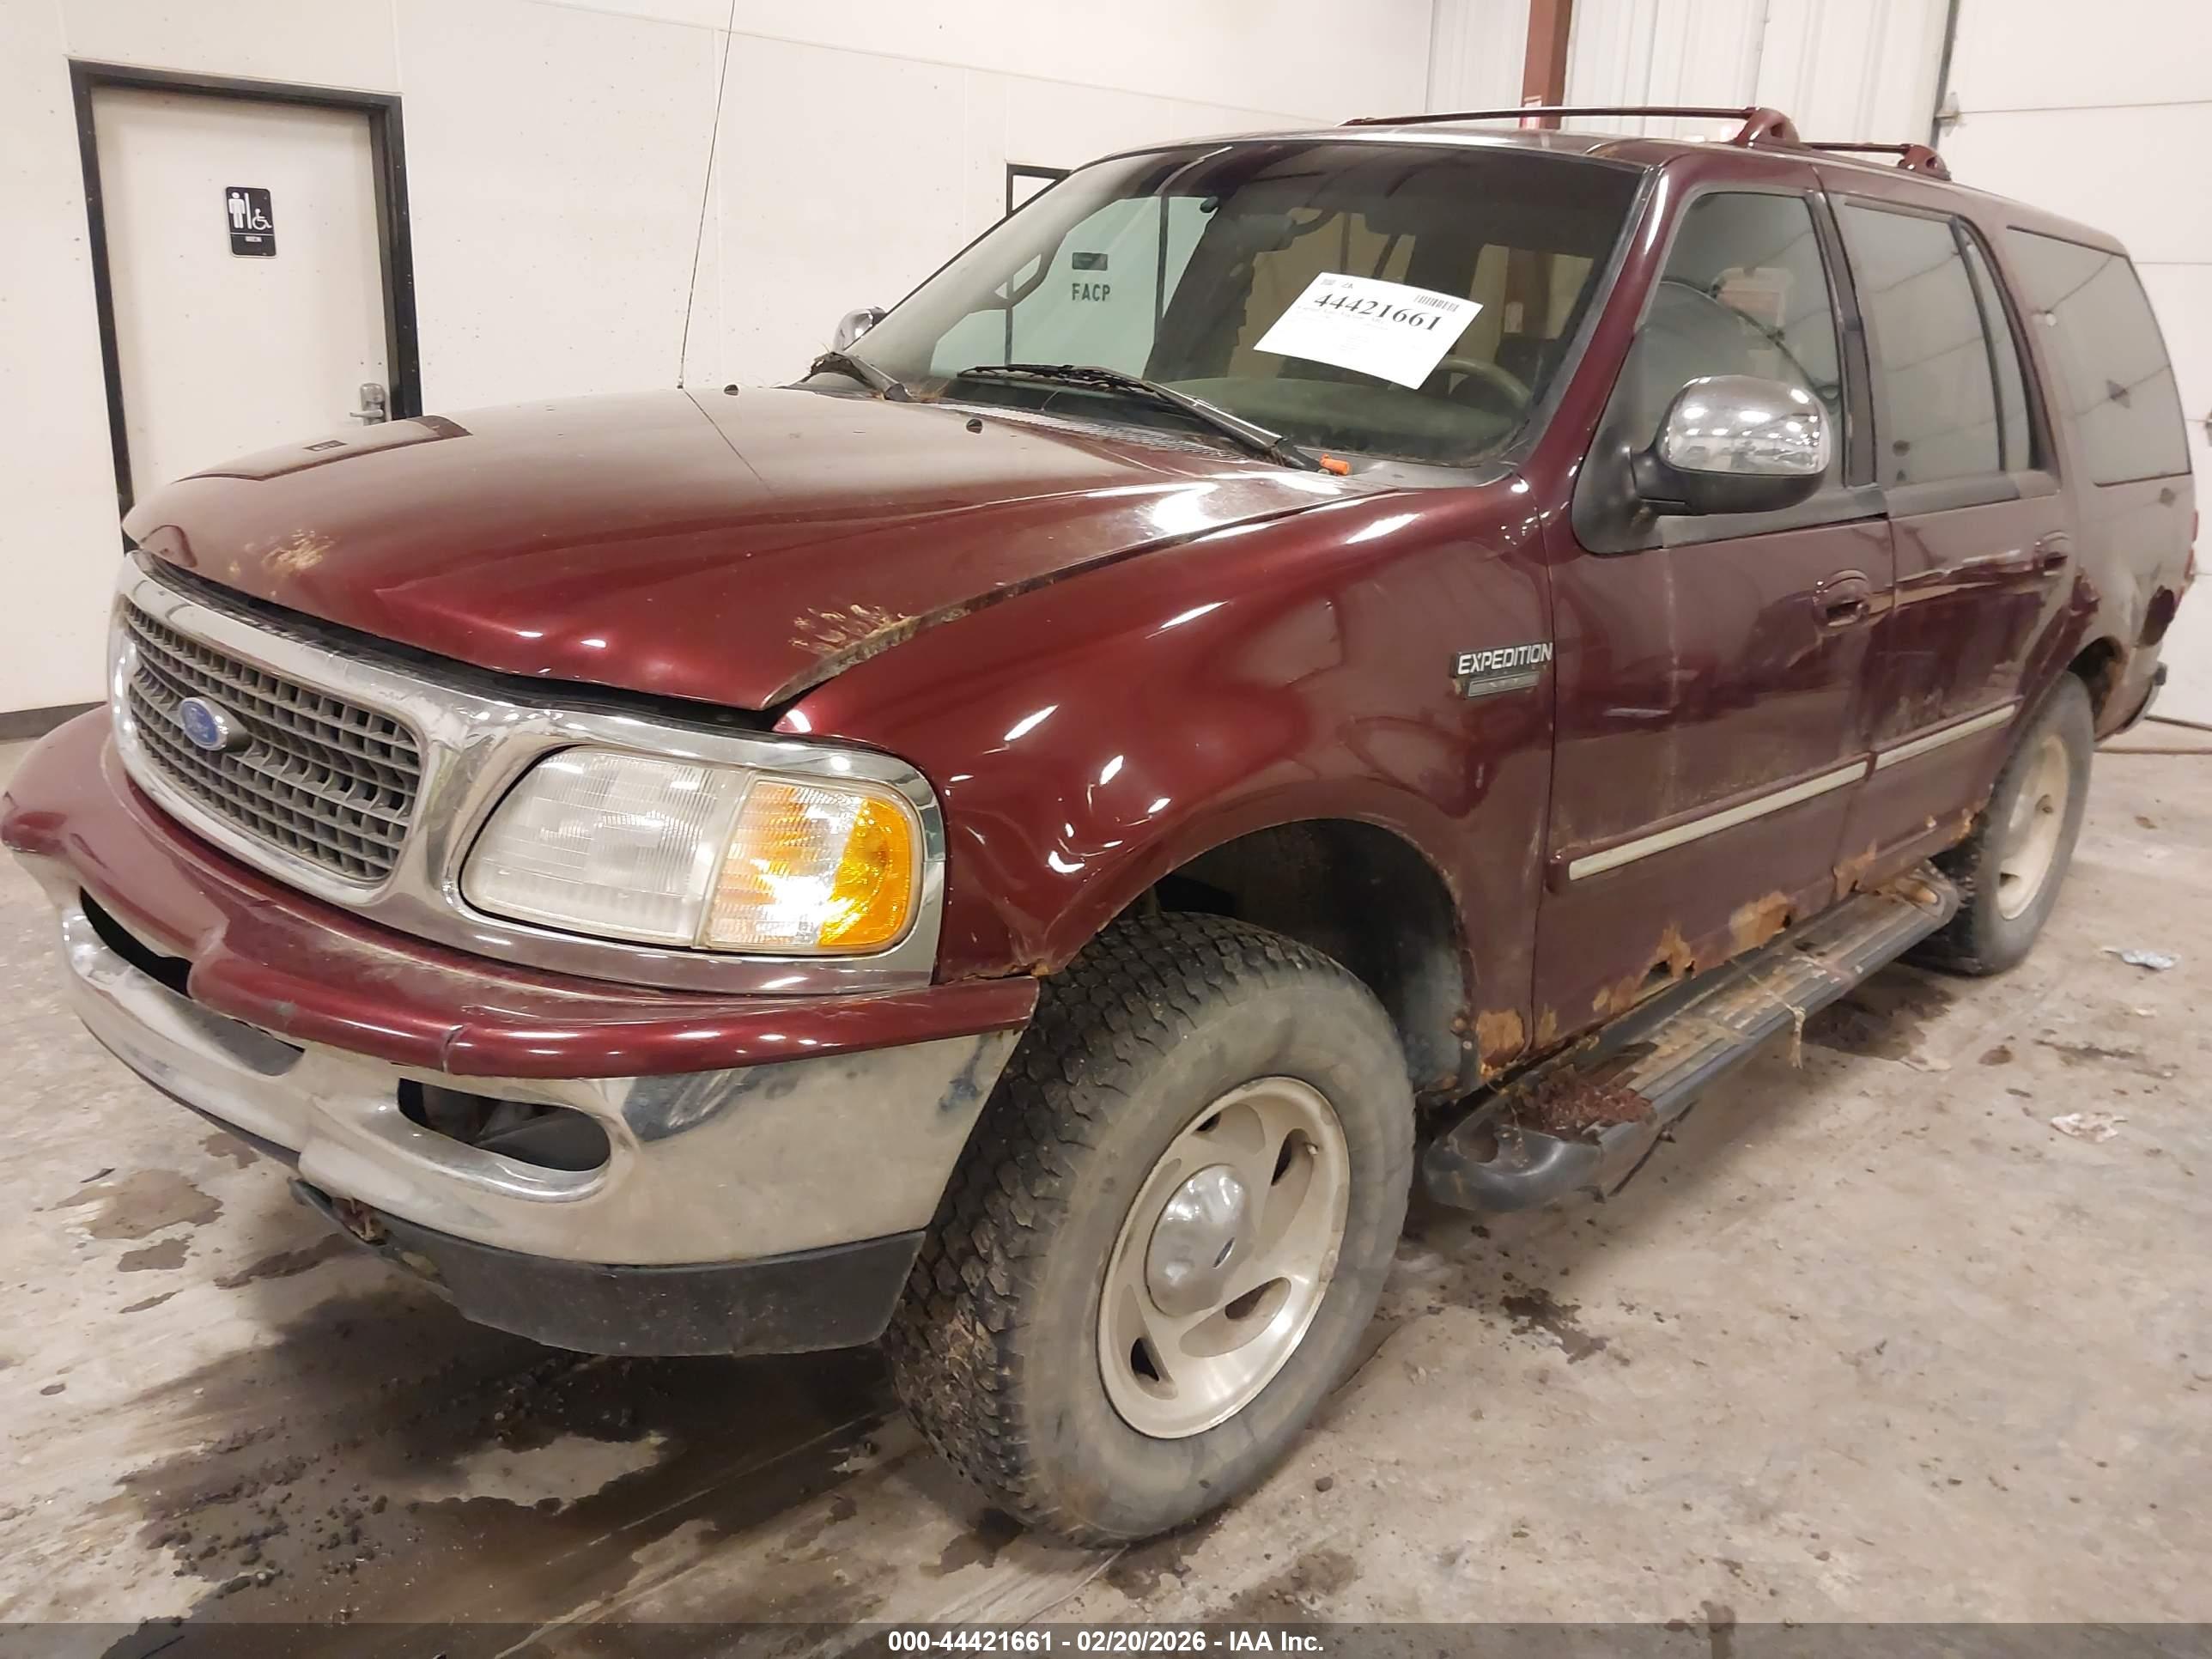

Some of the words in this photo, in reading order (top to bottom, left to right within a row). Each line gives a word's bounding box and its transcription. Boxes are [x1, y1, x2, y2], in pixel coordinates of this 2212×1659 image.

[1072, 283, 1110, 301] FACP
[1314, 293, 1443, 331] 44421661
[1457, 642, 1553, 675] EXPEDITION
